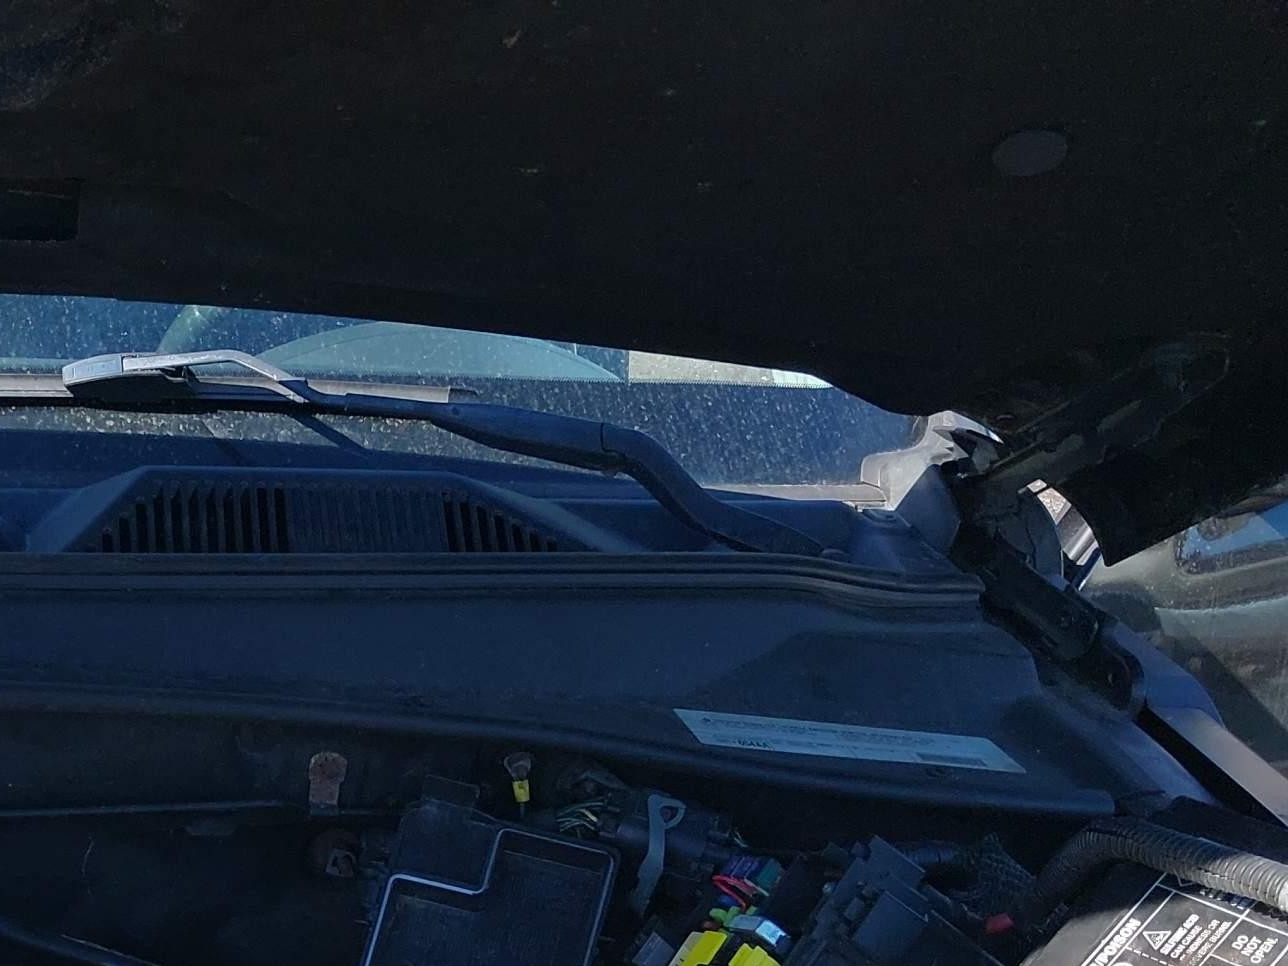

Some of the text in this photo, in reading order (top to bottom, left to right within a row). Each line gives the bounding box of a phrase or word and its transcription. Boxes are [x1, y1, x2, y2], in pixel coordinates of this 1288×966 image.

[1169, 924, 1202, 958] CAN CAUSE
[1231, 932, 1249, 950] DO
[1241, 936, 1261, 957] NOT
[1249, 937, 1278, 964] OPEN.
